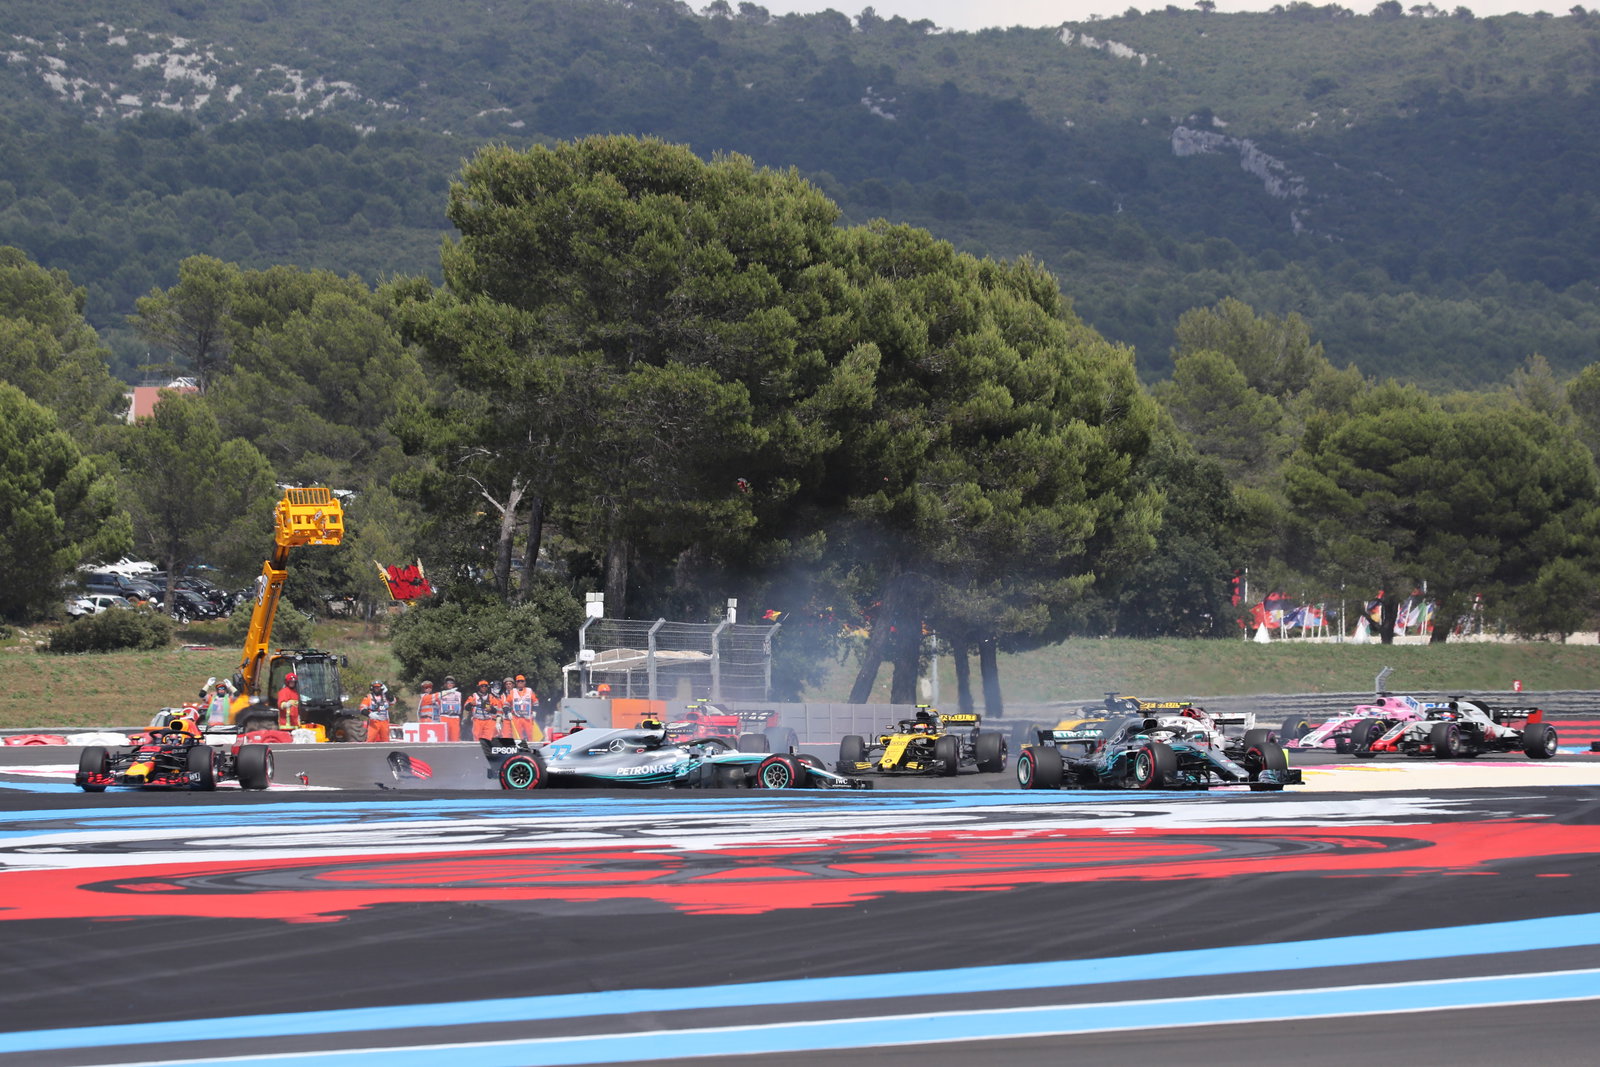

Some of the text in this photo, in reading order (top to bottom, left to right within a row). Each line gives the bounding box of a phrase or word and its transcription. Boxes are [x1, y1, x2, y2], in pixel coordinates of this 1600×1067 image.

[491, 746, 518, 754] EPSON
[549, 744, 572, 761] 77
[616, 764, 674, 776] PETRONAS
